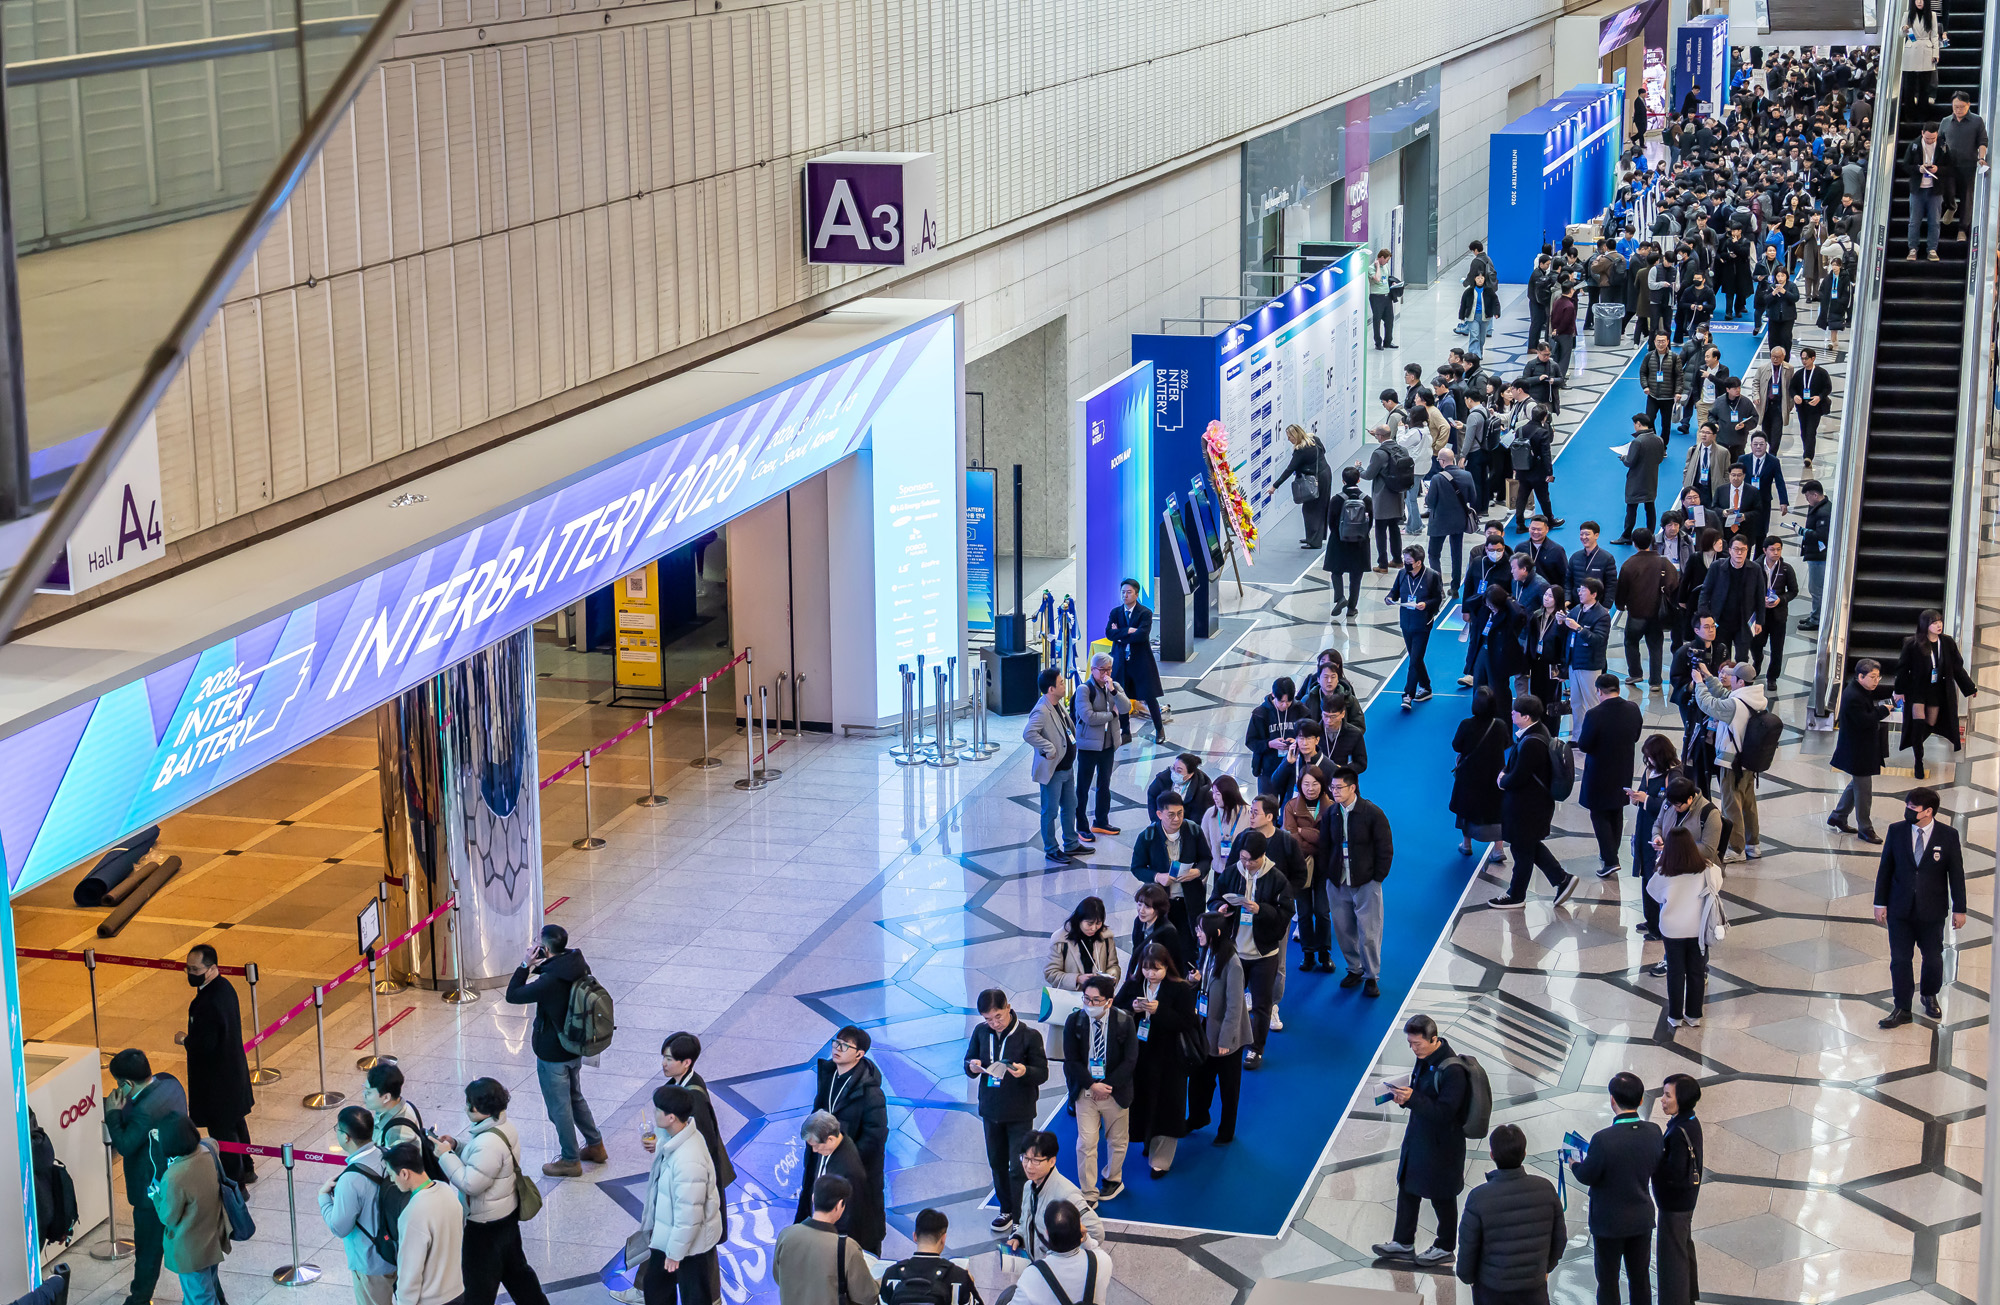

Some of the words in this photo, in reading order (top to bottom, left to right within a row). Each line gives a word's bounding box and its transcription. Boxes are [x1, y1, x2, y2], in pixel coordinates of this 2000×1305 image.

[814, 179, 901, 251] A3
[912, 243, 920, 257] Hall
[921, 208, 937, 253] A3
[1156, 368, 1168, 415] BATTERY
[1168, 369, 1179, 402] INTER
[1180, 369, 1188, 390] 2026
[899, 482, 934, 496] Sponsors
[88, 545, 114, 573] Hall
[117, 483, 162, 562] A4
[326, 473, 676, 702] INTERBATTERY
[646, 433, 761, 539] 2026
[192, 661, 245, 704] 2026
[172, 683, 254, 749] INTER
[151, 709, 265, 792] BATTERY
[60, 1084, 96, 1130] coex
[246, 1145, 264, 1154] coex
[304, 1152, 324, 1162] coex
